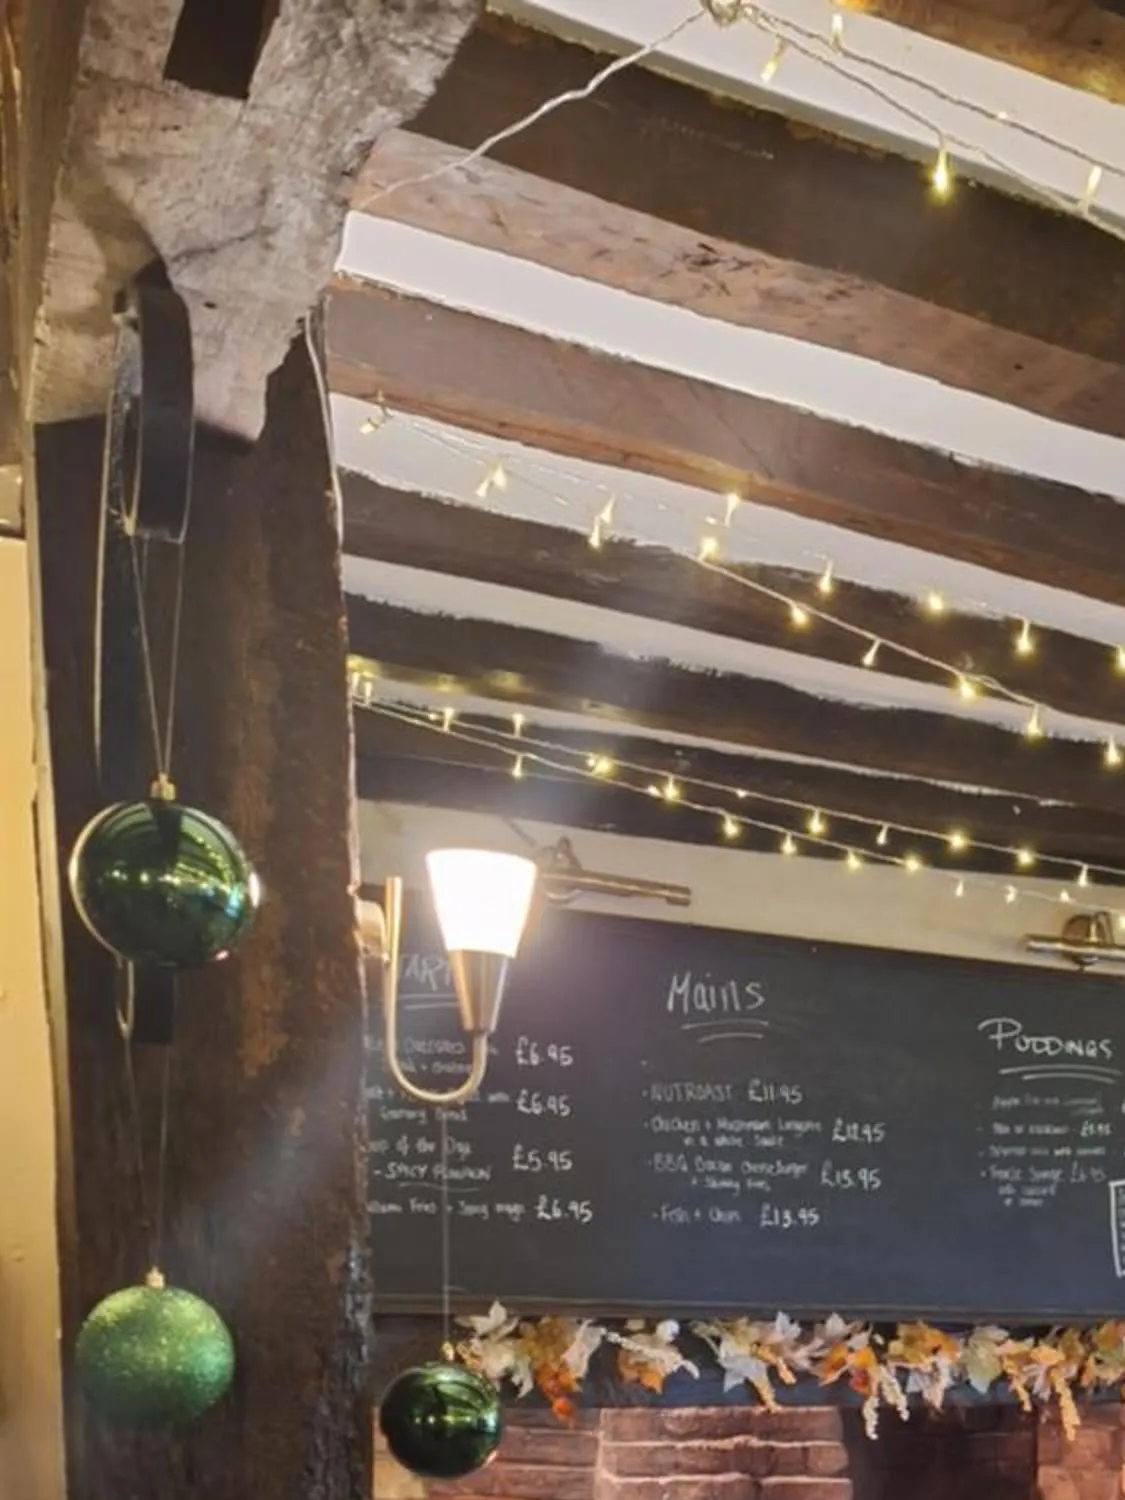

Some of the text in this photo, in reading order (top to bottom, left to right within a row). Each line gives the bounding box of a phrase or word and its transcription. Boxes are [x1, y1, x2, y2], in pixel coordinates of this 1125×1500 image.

[667, 970, 765, 1013] Mains
[516, 1036, 574, 1066] £6.95
[512, 1143, 573, 1172] £5.95
[536, 1194, 593, 1223] £6.95
